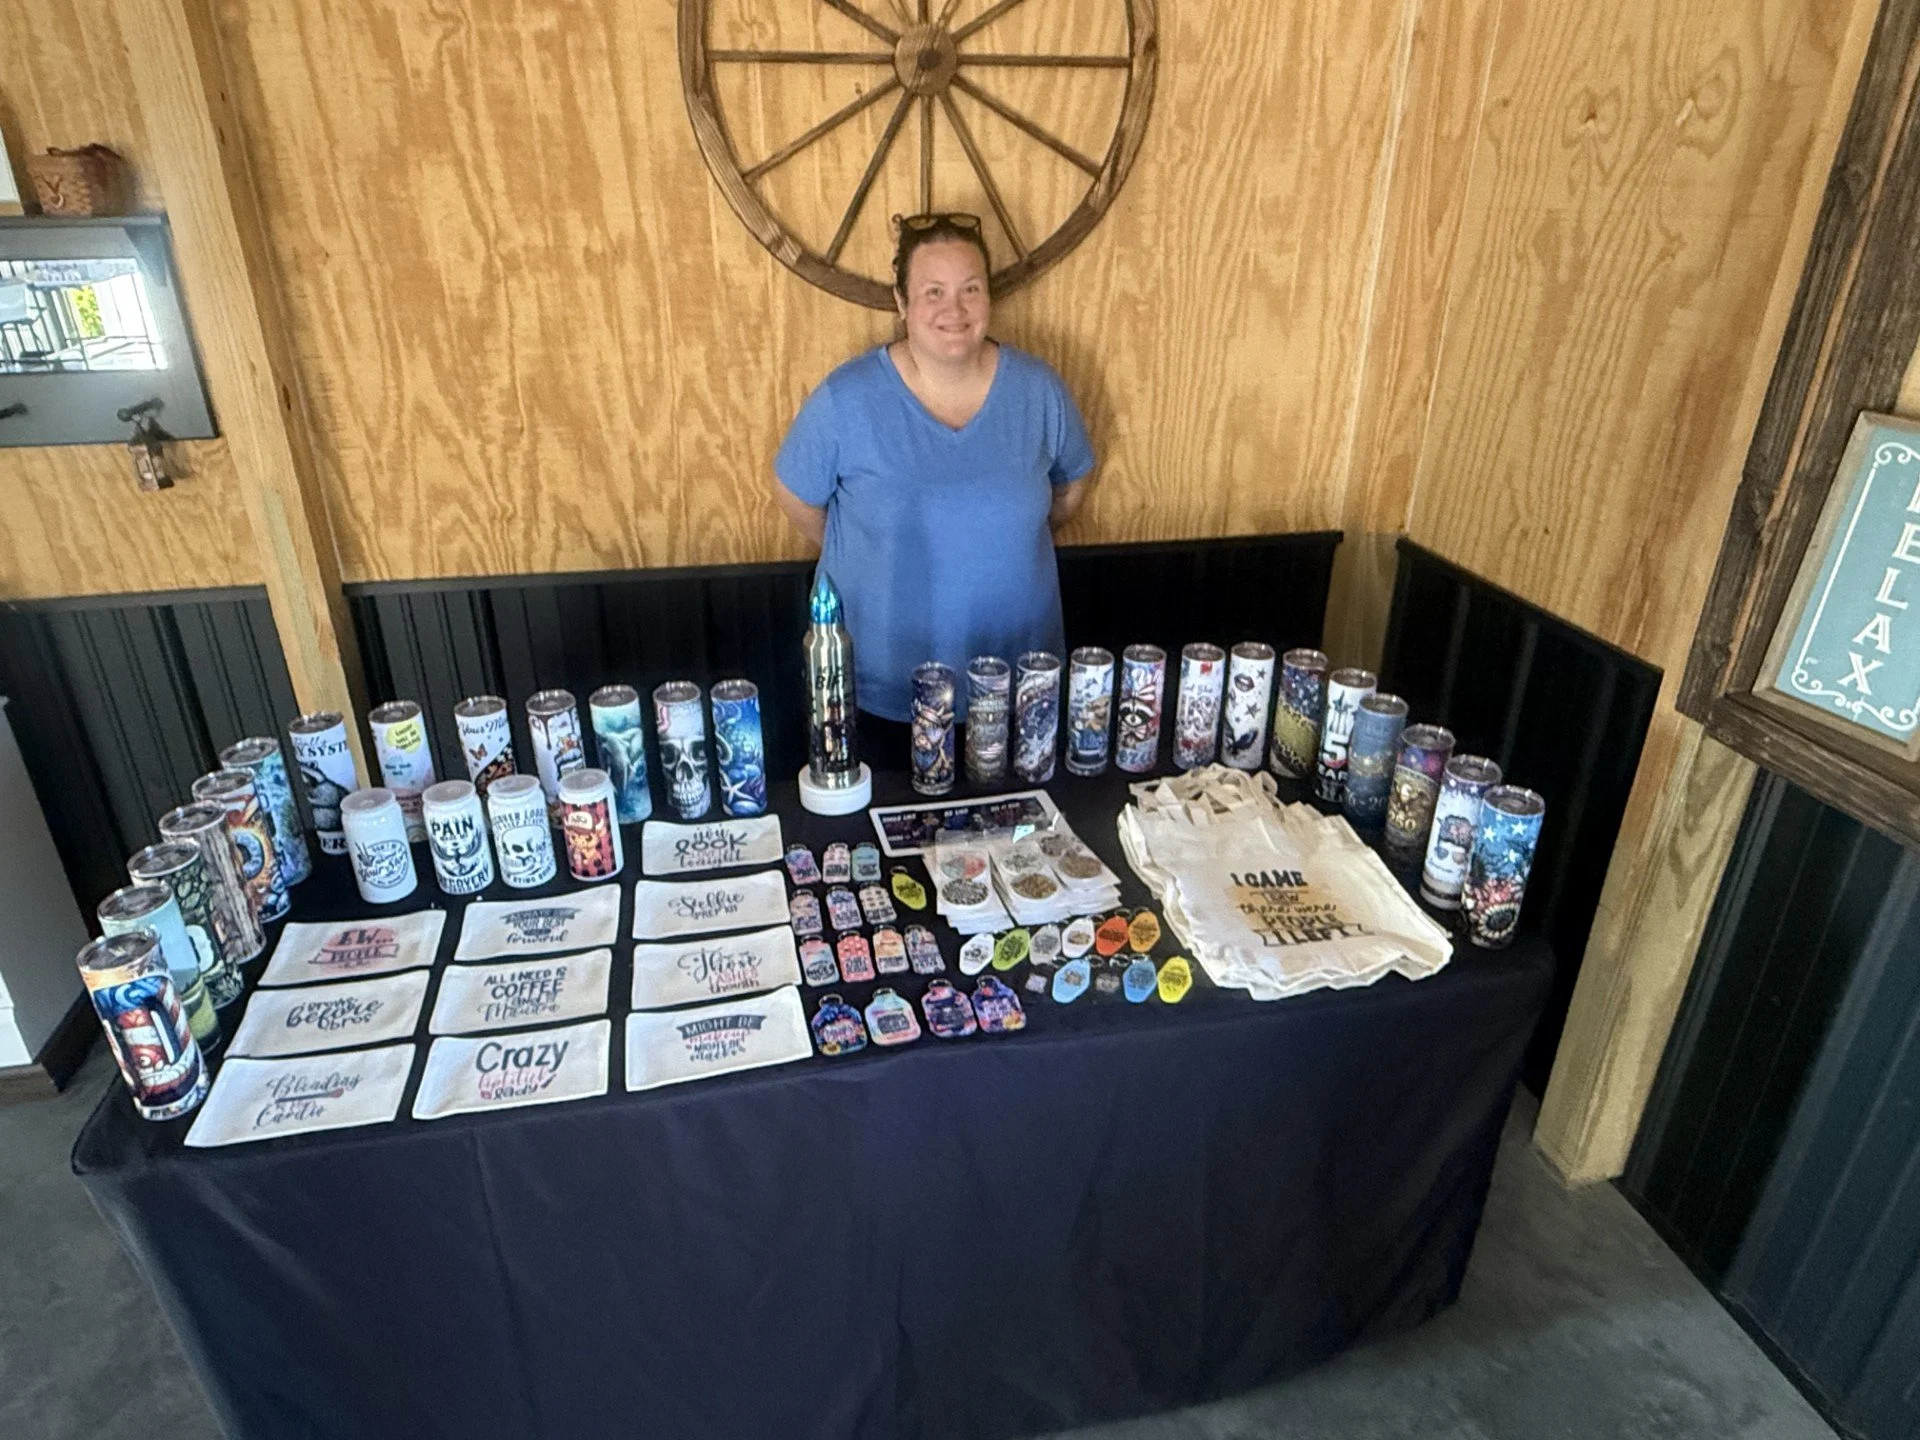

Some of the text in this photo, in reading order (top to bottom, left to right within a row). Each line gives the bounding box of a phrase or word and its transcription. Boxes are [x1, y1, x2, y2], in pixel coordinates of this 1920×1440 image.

[431, 814, 473, 836] PAIN
[484, 974, 506, 986] ALL
[491, 979, 564, 1000] COFFEE
[476, 1041, 570, 1073] Crazy
